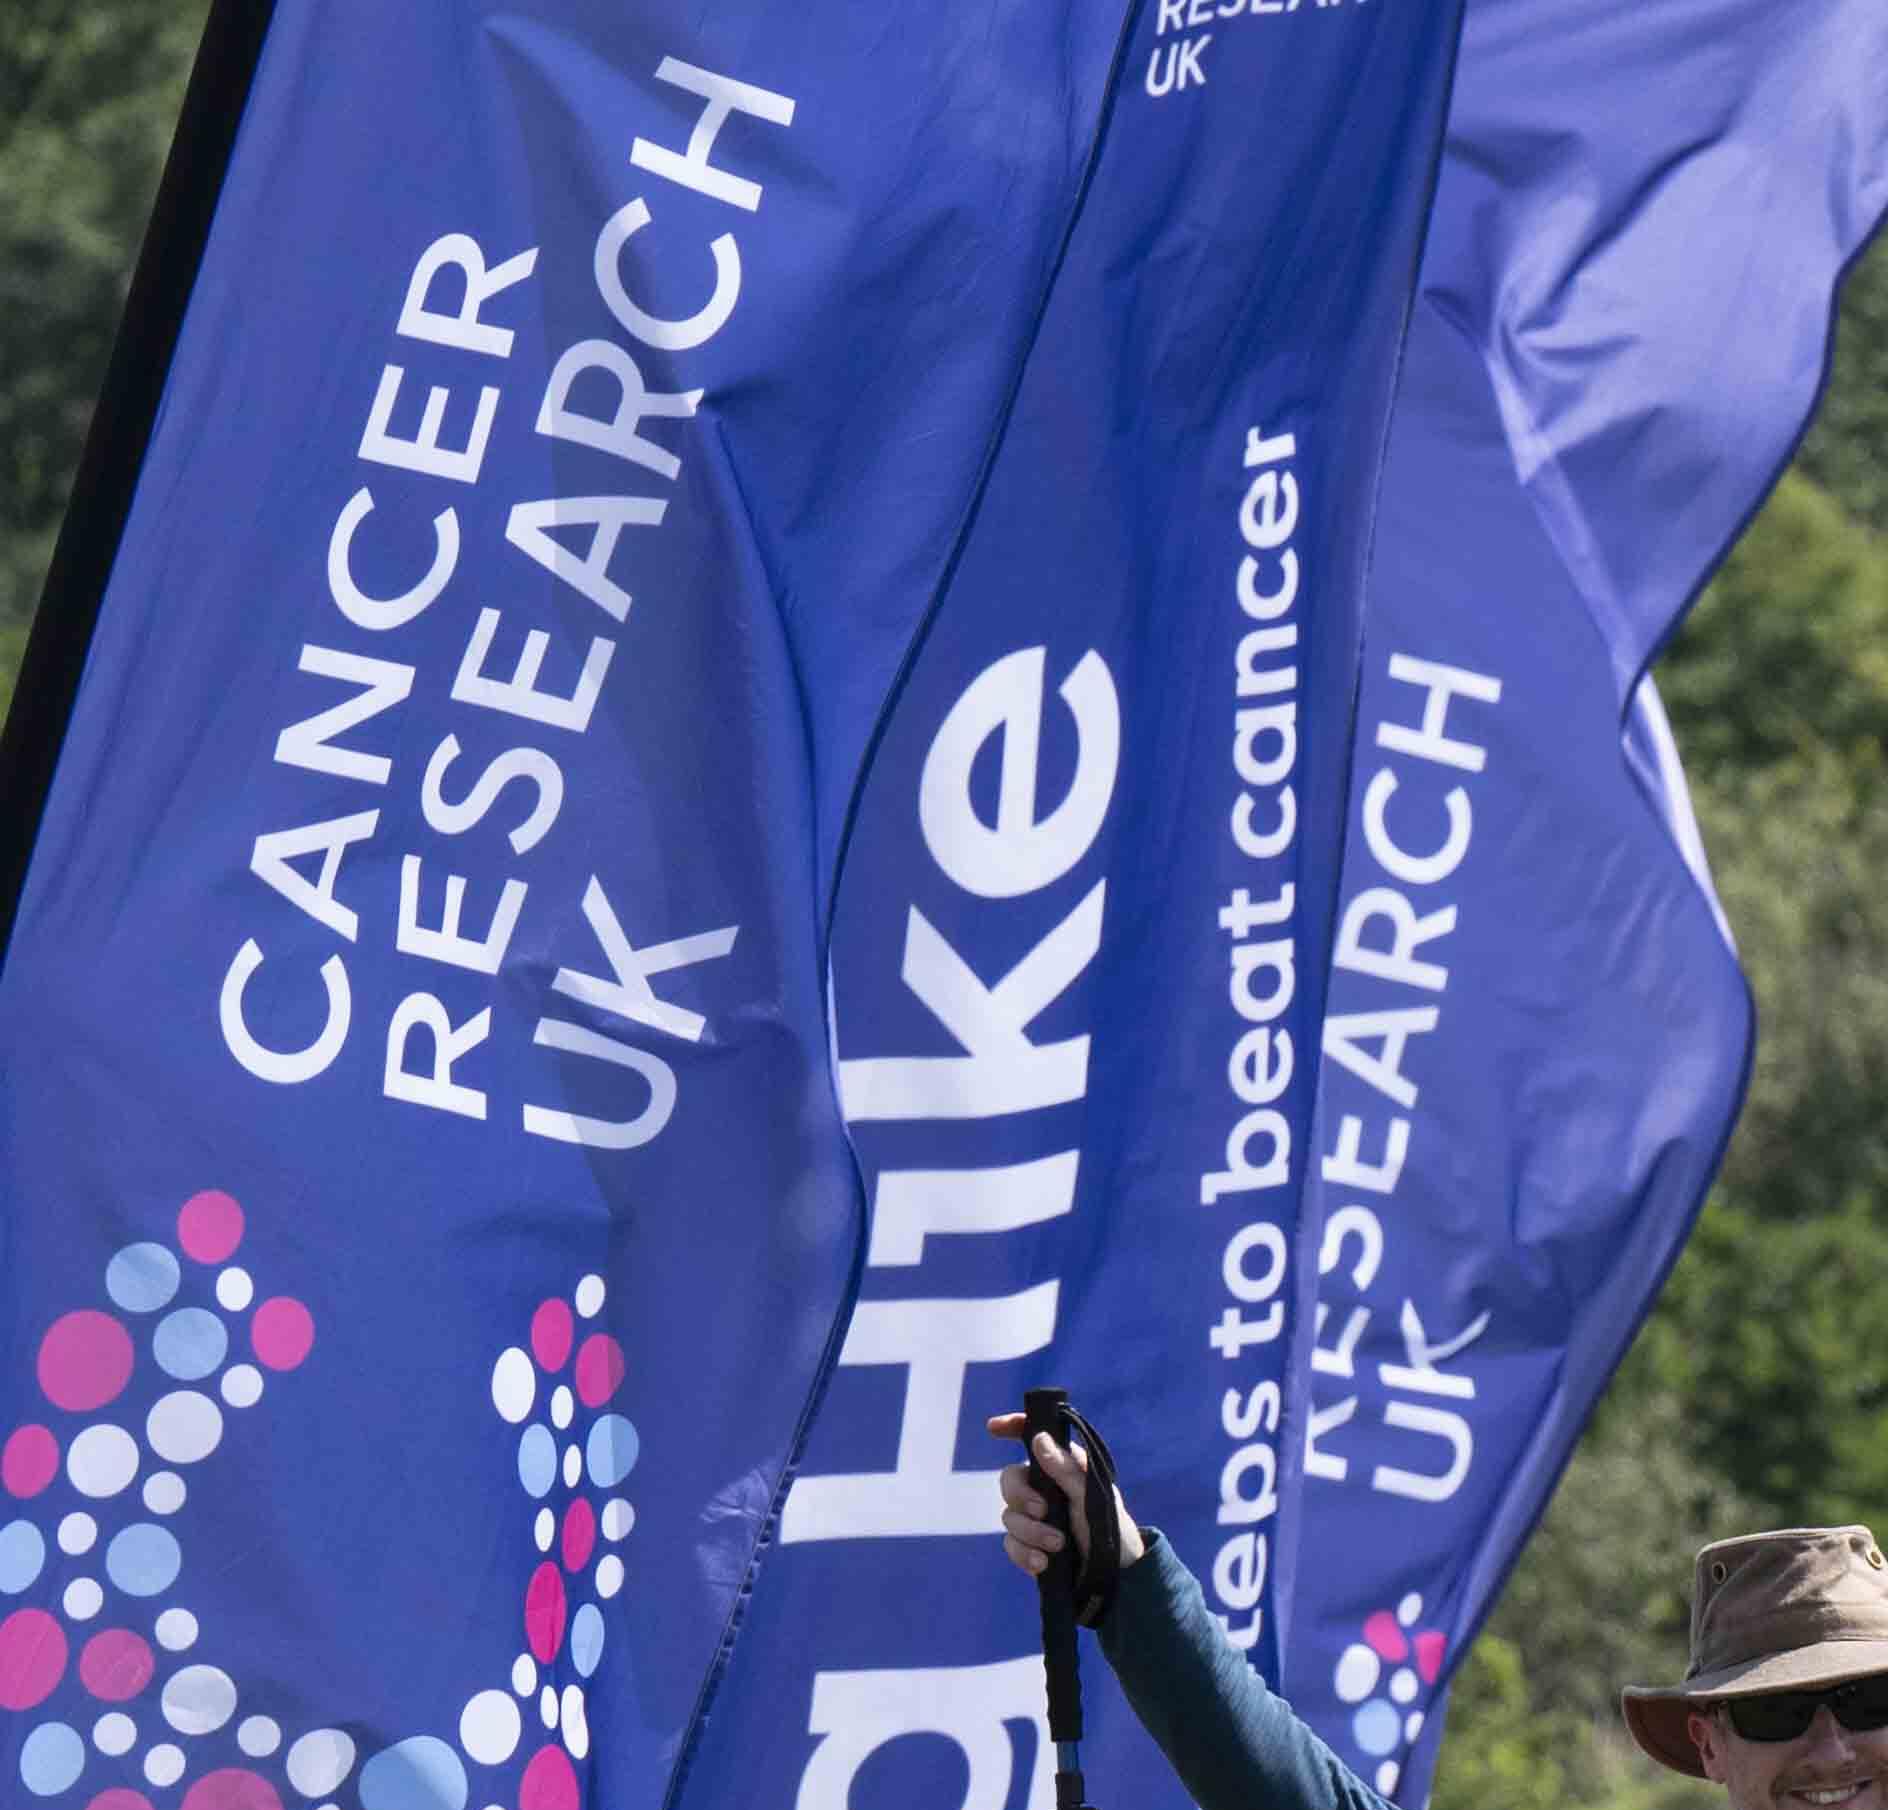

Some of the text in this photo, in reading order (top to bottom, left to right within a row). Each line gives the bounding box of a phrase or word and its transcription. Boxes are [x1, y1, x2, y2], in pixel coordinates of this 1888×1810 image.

[1145, 34, 1212, 97] UK
[220, 233, 539, 1084] CANCER
[383, 56, 796, 1121] RESEARCH
[1231, 427, 1299, 859] cancer
[523, 875, 739, 1149] UK
[778, 645, 1121, 1546] Hike
[1201, 882, 1295, 1206] beat
[1303, 652, 1503, 1482] RESEARCH
[1209, 1222, 1287, 1359] to
[1372, 1298, 1492, 1502] UK
[1212, 1380, 1281, 1649] teps
